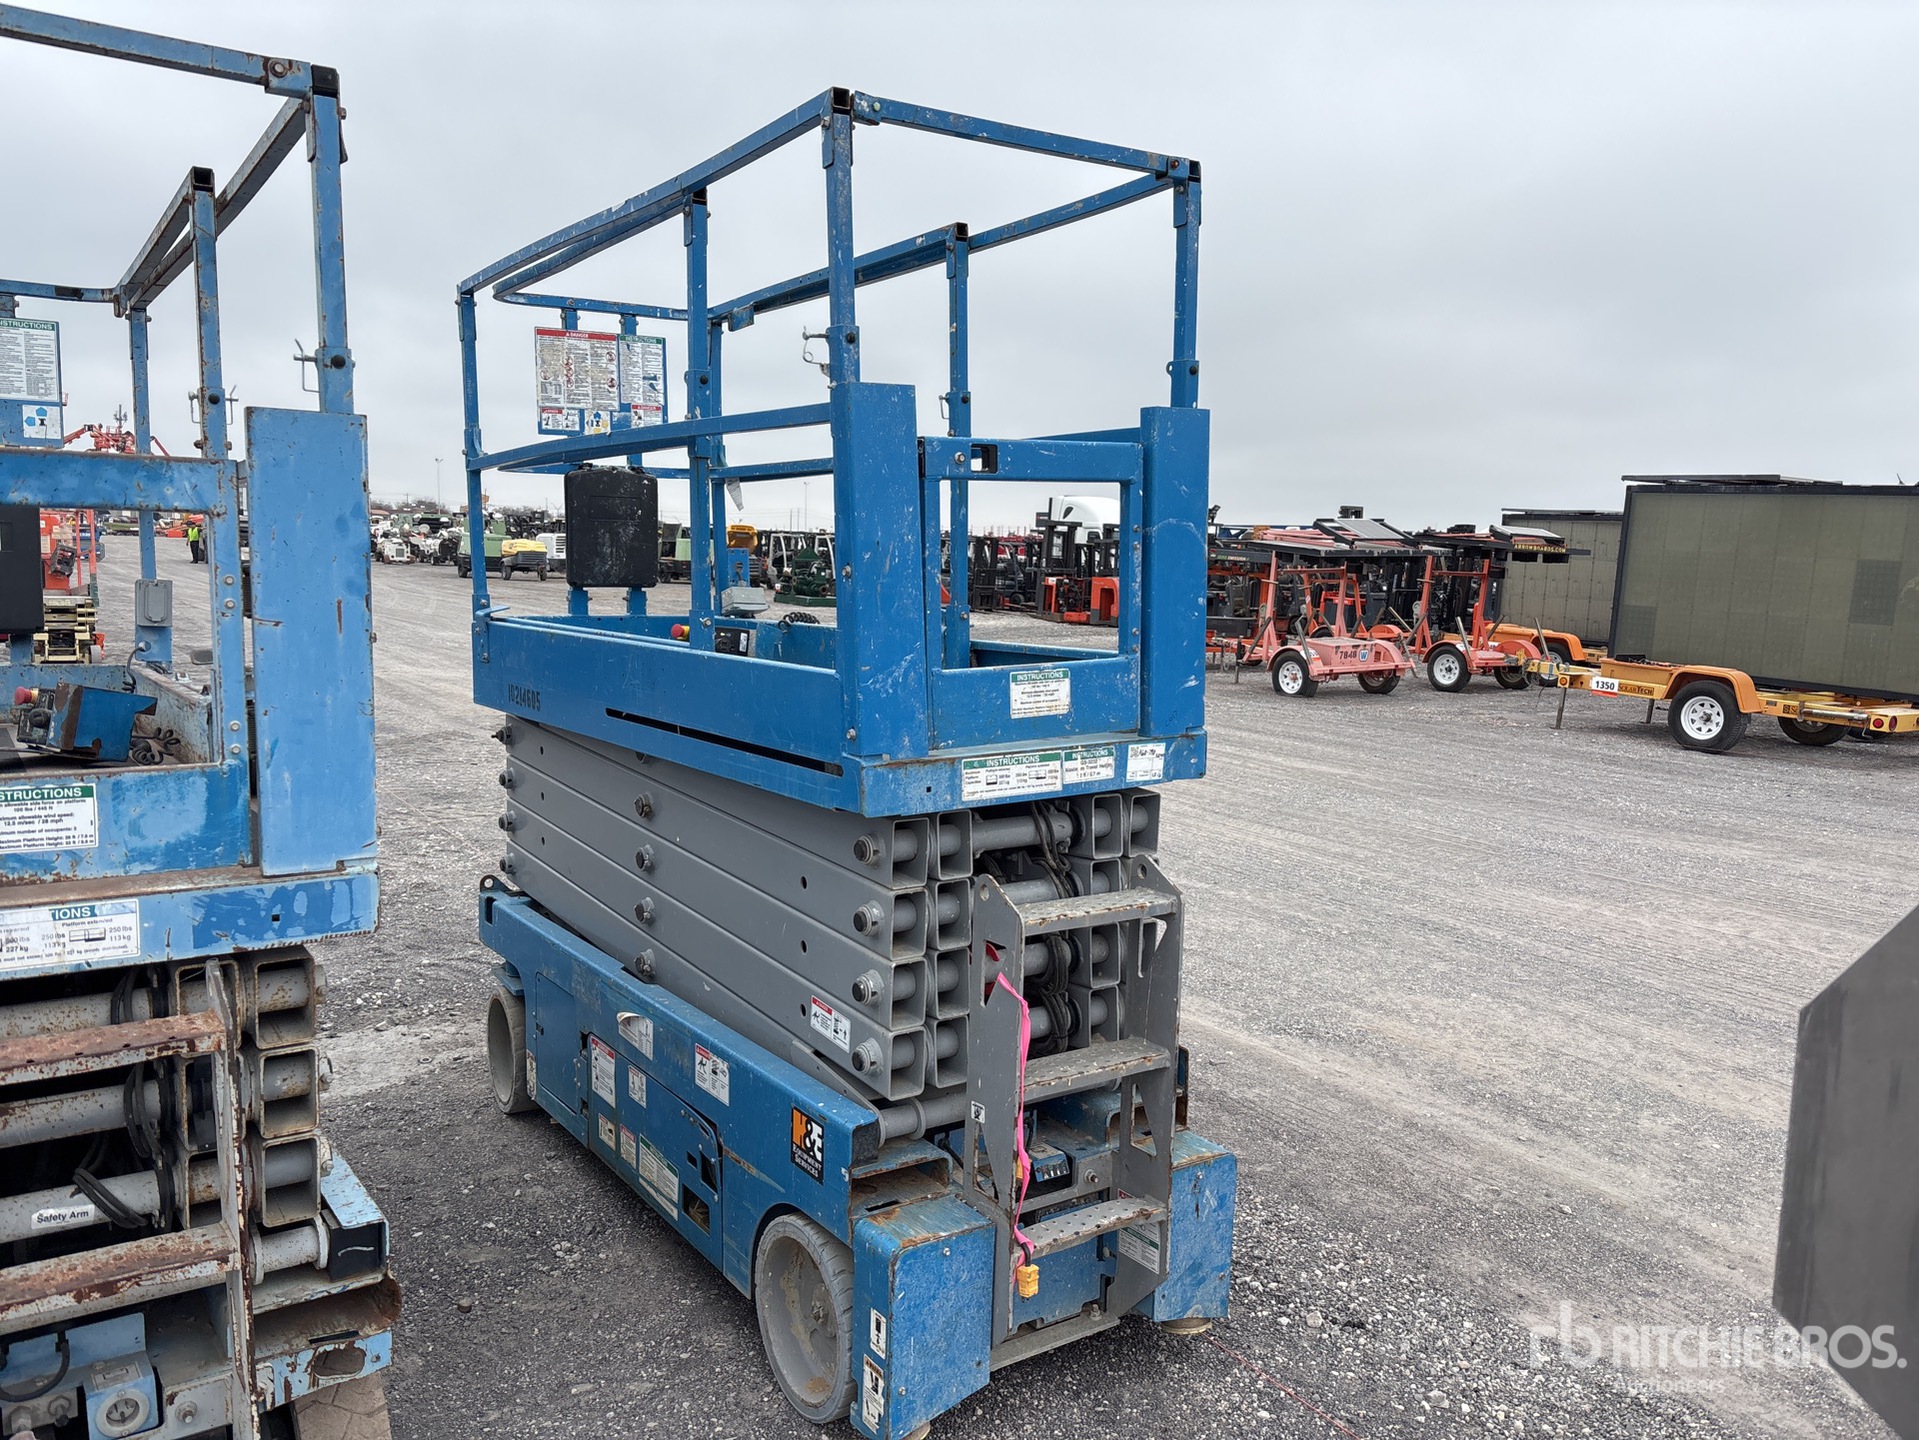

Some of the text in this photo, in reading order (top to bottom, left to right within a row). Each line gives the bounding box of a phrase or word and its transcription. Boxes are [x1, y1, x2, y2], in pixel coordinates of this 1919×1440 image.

[1017, 671, 1063, 680] INSTRUCTIONS
[1596, 680, 1615, 691] 1350
[1072, 748, 1109, 759] INSTRUCTIONS
[987, 755, 1040, 767] INSTRUCTIONS
[0, 787, 82, 801] STRUCTIONS
[37, 1213, 67, 1224] Safety
[69, 1211, 89, 1219] Arm
